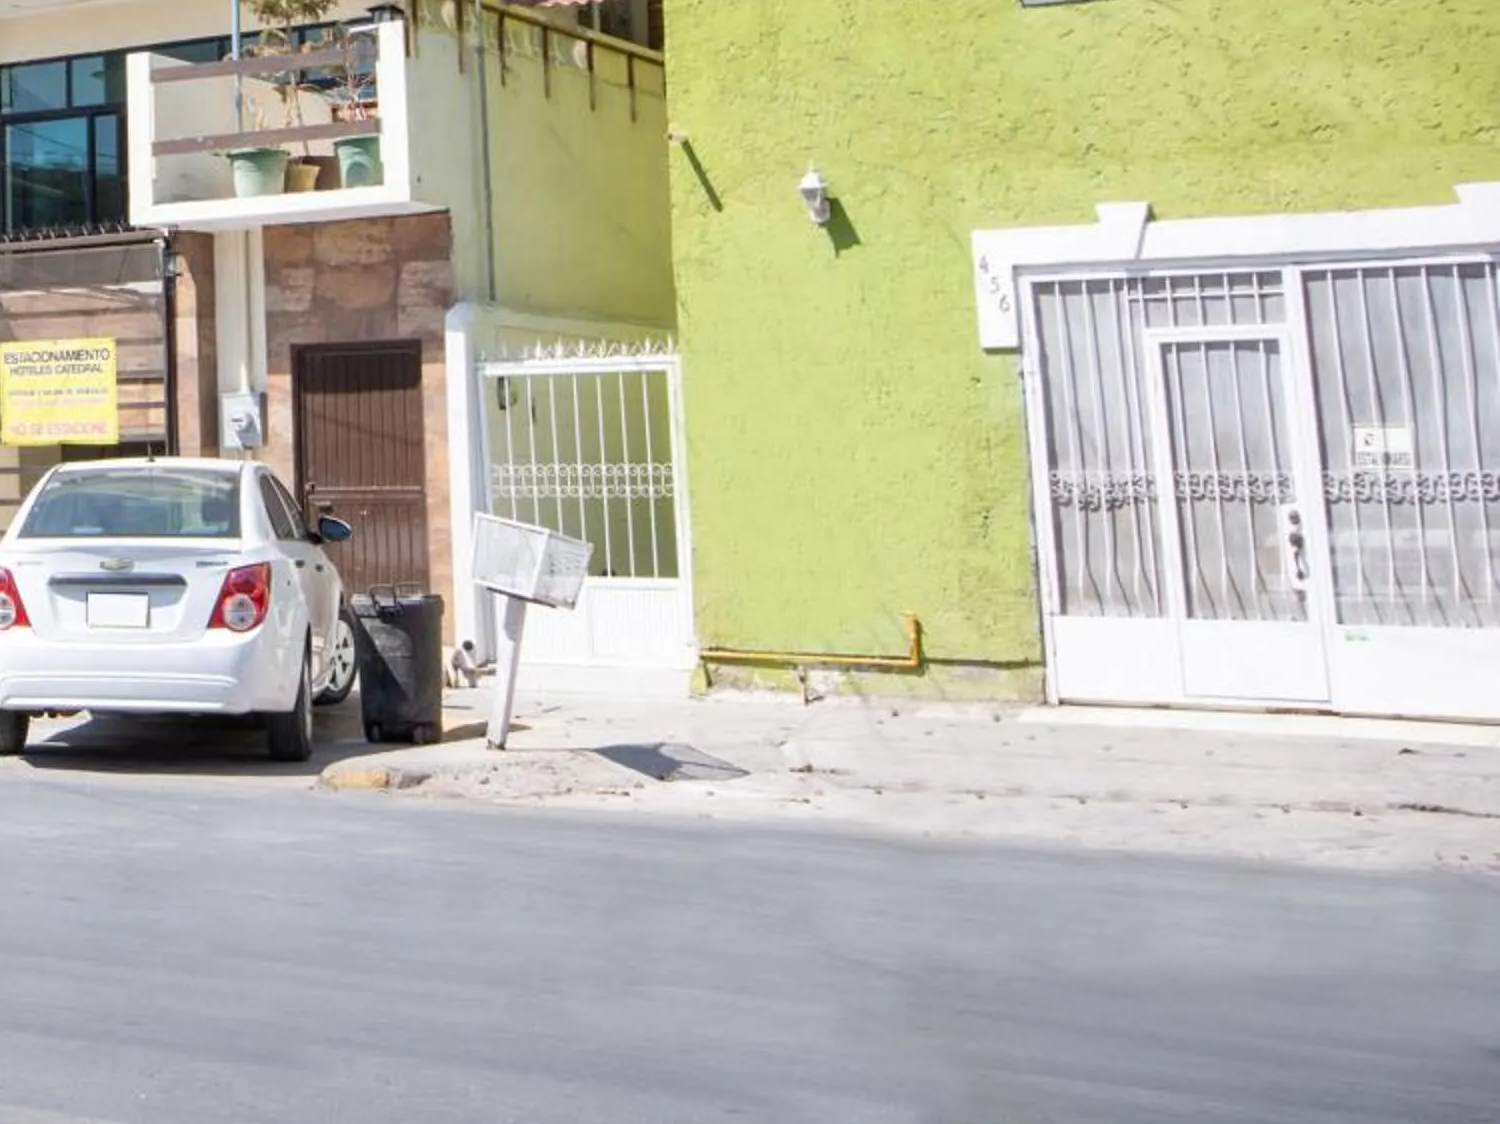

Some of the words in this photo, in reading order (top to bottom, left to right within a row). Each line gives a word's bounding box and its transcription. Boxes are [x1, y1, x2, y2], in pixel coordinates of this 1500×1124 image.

[979, 255, 1011, 313] 456
[3, 347, 110, 365] ESTACIONAMIENTO
[10, 365, 53, 377] HOTELES
[55, 363, 104, 375] CATEDRAL
